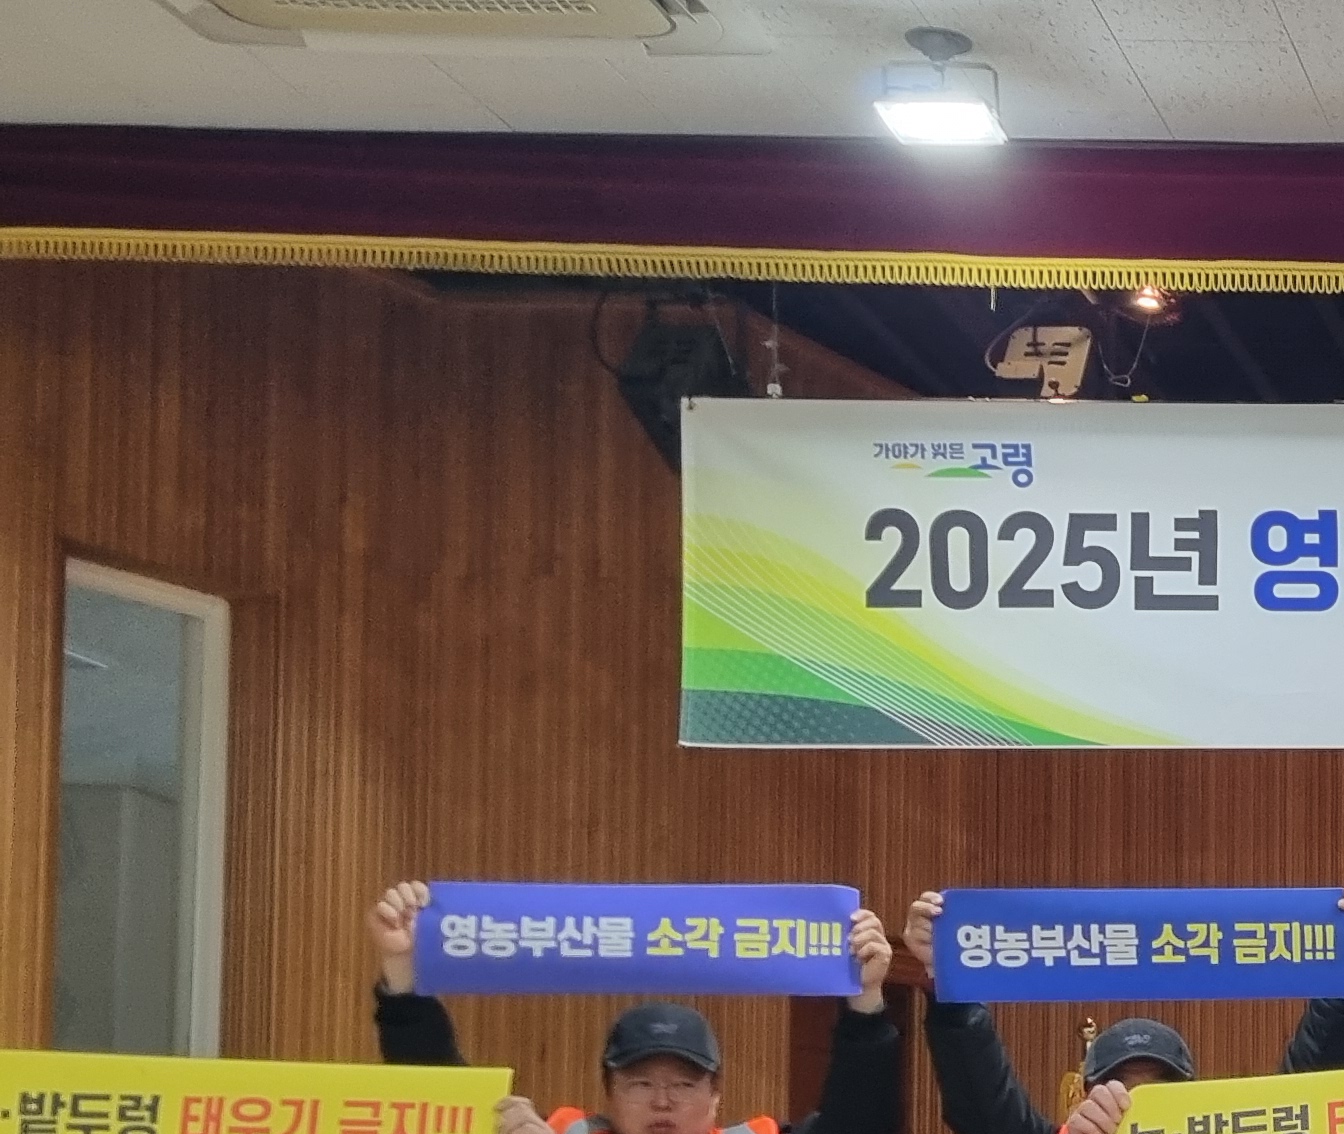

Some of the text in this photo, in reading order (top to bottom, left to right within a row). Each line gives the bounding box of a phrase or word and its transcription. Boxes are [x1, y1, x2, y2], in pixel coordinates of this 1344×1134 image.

[971, 442, 1034, 489] 고령
[864, 508, 1219, 611] 2025년
[441, 915, 842, 958] 영농부산물 소각 금지!!!
[957, 922, 1335, 967] 영농부산물 소각 금지!!!
